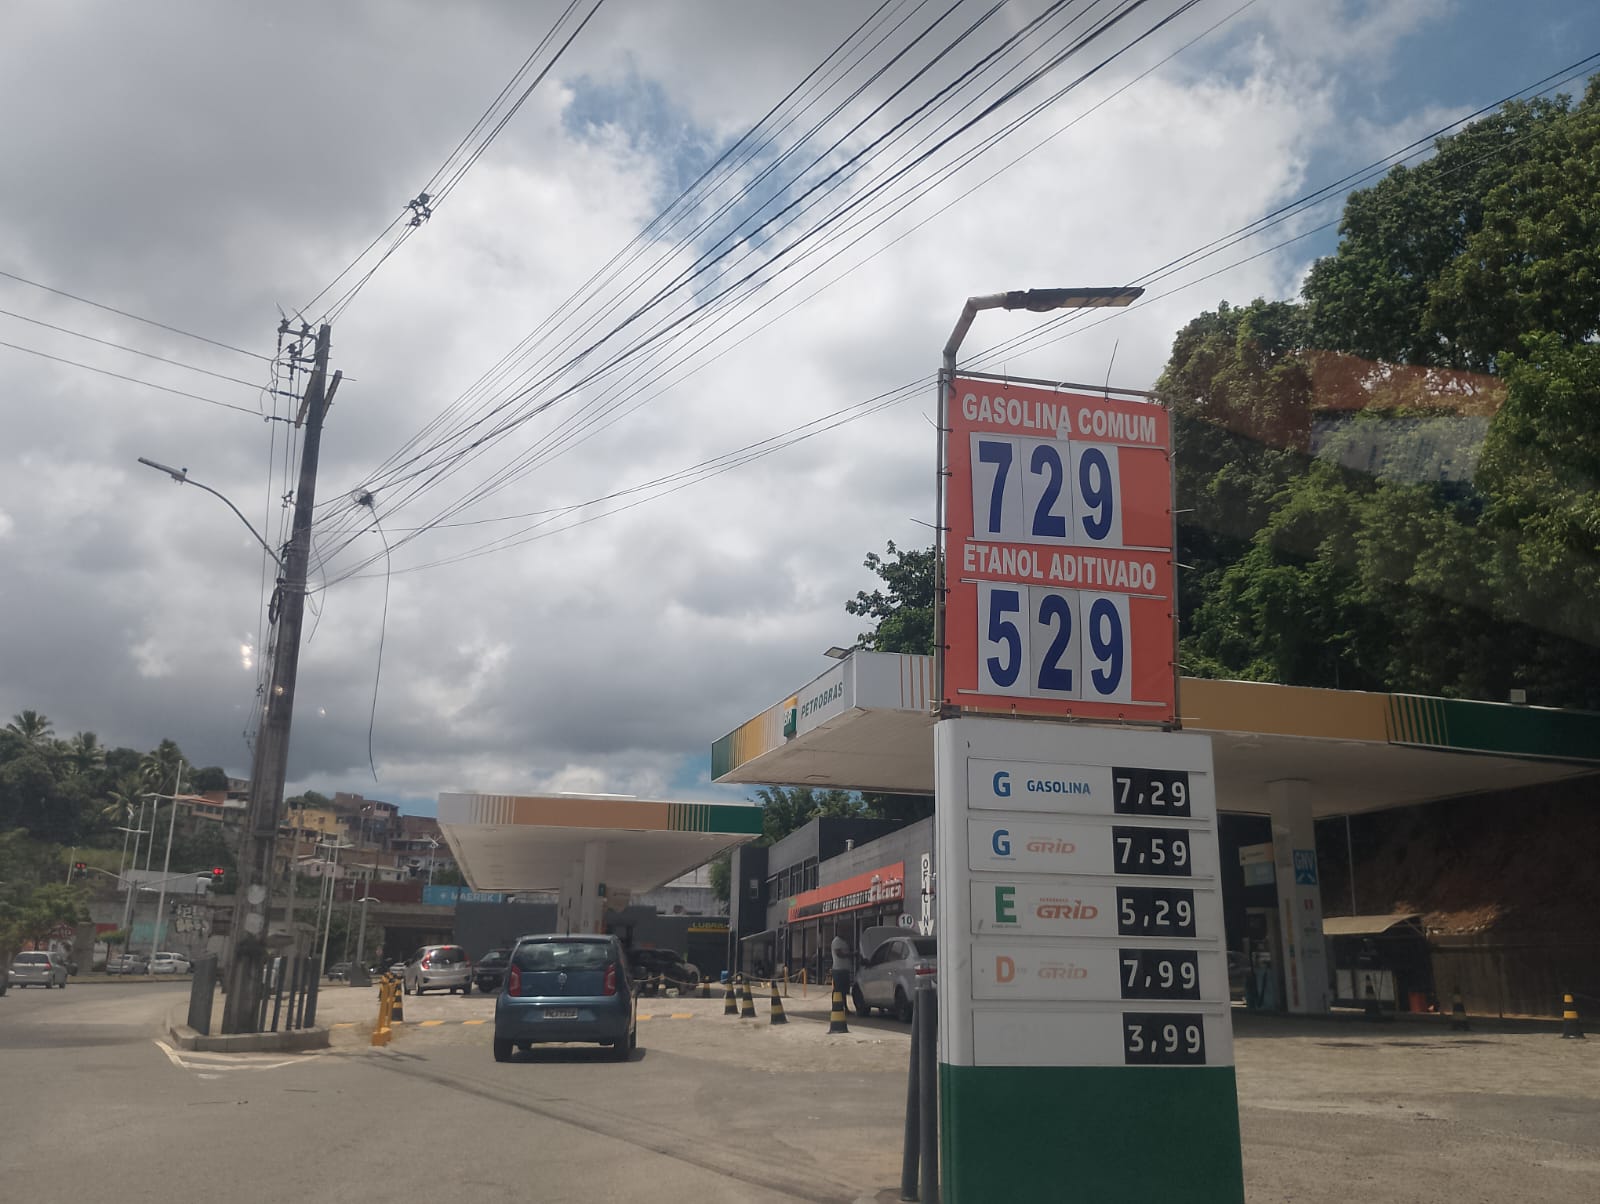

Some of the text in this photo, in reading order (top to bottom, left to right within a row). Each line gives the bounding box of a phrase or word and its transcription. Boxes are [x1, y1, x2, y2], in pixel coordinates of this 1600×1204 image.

[962, 393, 1157, 443] GASOLINA COMUM
[978, 440, 1114, 541] 729
[963, 543, 1157, 590] ETANOL ADITIVADO
[986, 589, 1124, 696] 529
[801, 682, 843, 719] PETROBRAS
[993, 771, 1186, 807] G GASOLINA 7,29
[992, 829, 1011, 856] G
[1117, 837, 1187, 866] 7,59
[995, 886, 1017, 923] E
[1121, 898, 1191, 927] 5,29
[996, 956, 1015, 984] D
[1123, 959, 1195, 989] 7,99
[1128, 1024, 1200, 1054] 3,99
